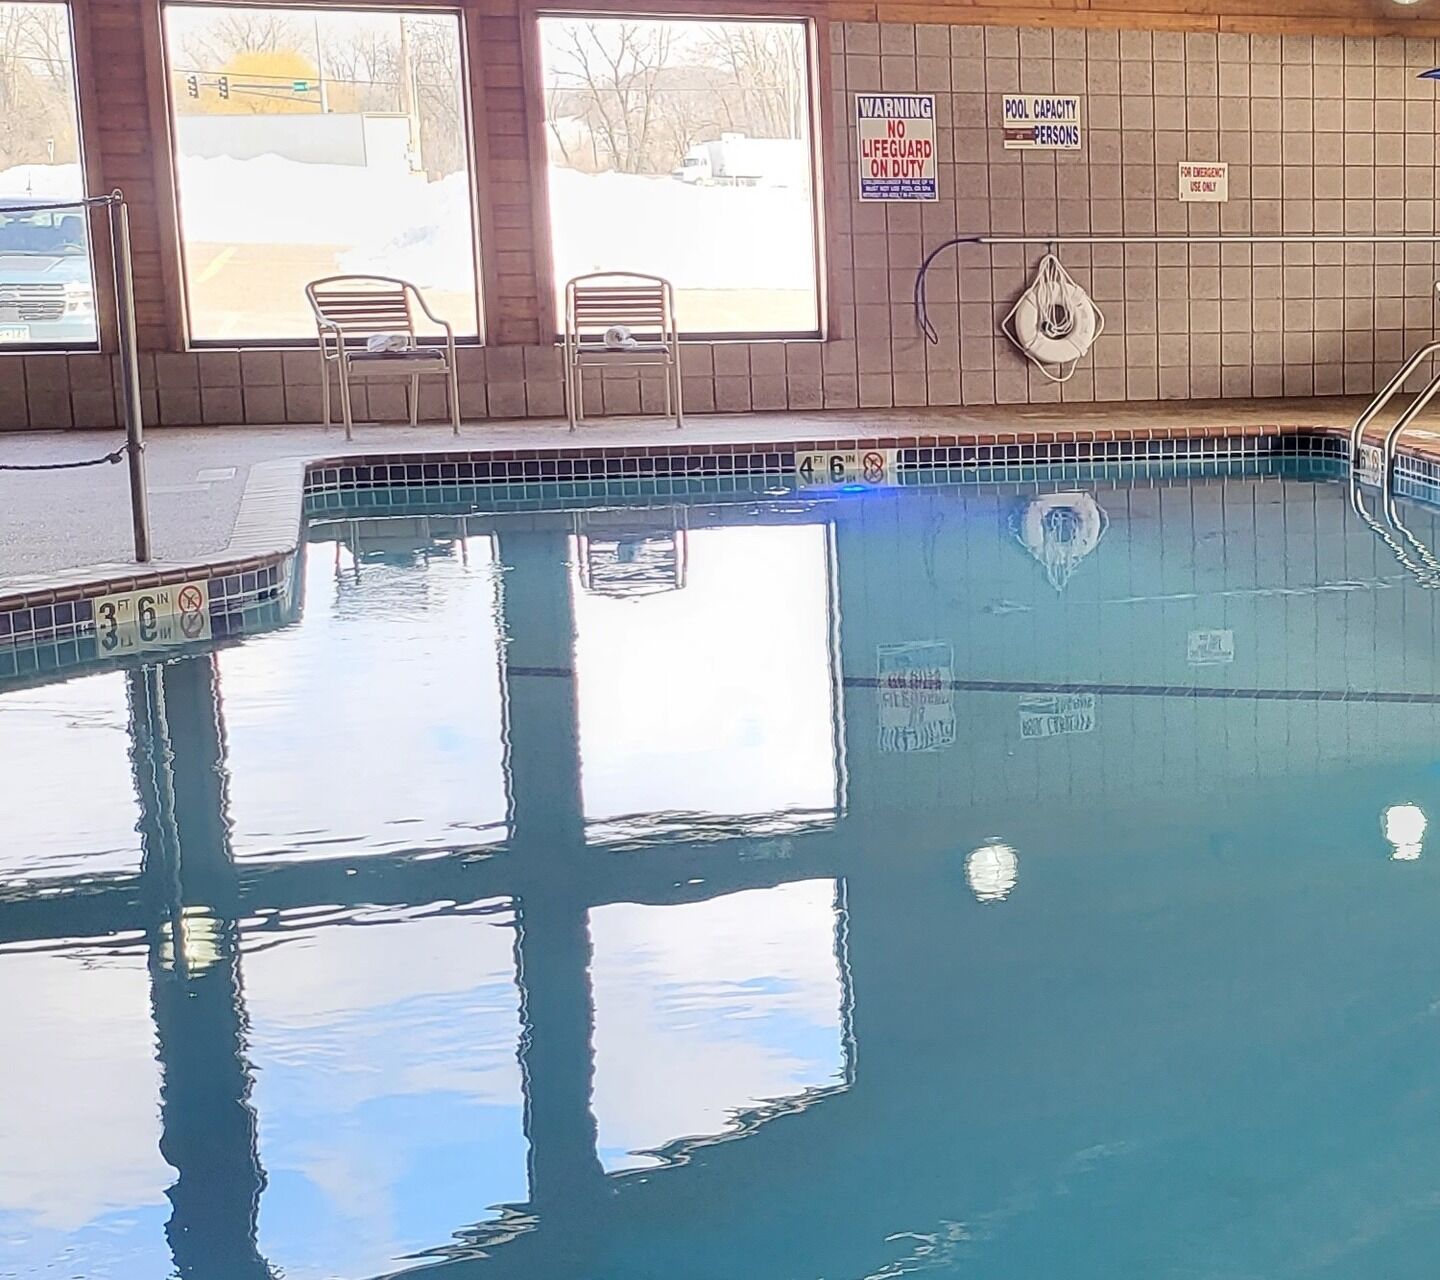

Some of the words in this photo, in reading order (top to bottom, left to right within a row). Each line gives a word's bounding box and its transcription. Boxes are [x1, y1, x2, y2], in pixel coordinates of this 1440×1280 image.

[860, 98, 931, 117] WARNING
[1006, 99, 1029, 118] POOL
[1034, 99, 1077, 119] CAPACITY
[888, 120, 905, 138] NO
[1034, 125, 1079, 145] PERSONS
[862, 140, 931, 158] LIFEGUARD
[871, 159, 888, 177] ON
[892, 160, 924, 177] DUTY
[1181, 167, 1191, 178] FOR
[1193, 167, 1225, 178] EMERGENCY
[1190, 181, 1201, 192] USE
[1202, 181, 1216, 192] ONLY
[800, 456, 814, 471] 4
[830, 456, 844, 473] 6
[99, 603, 117, 628] 3
[118, 599, 130, 611] FT
[138, 596, 156, 622] 6
[157, 592, 168, 604] IN
